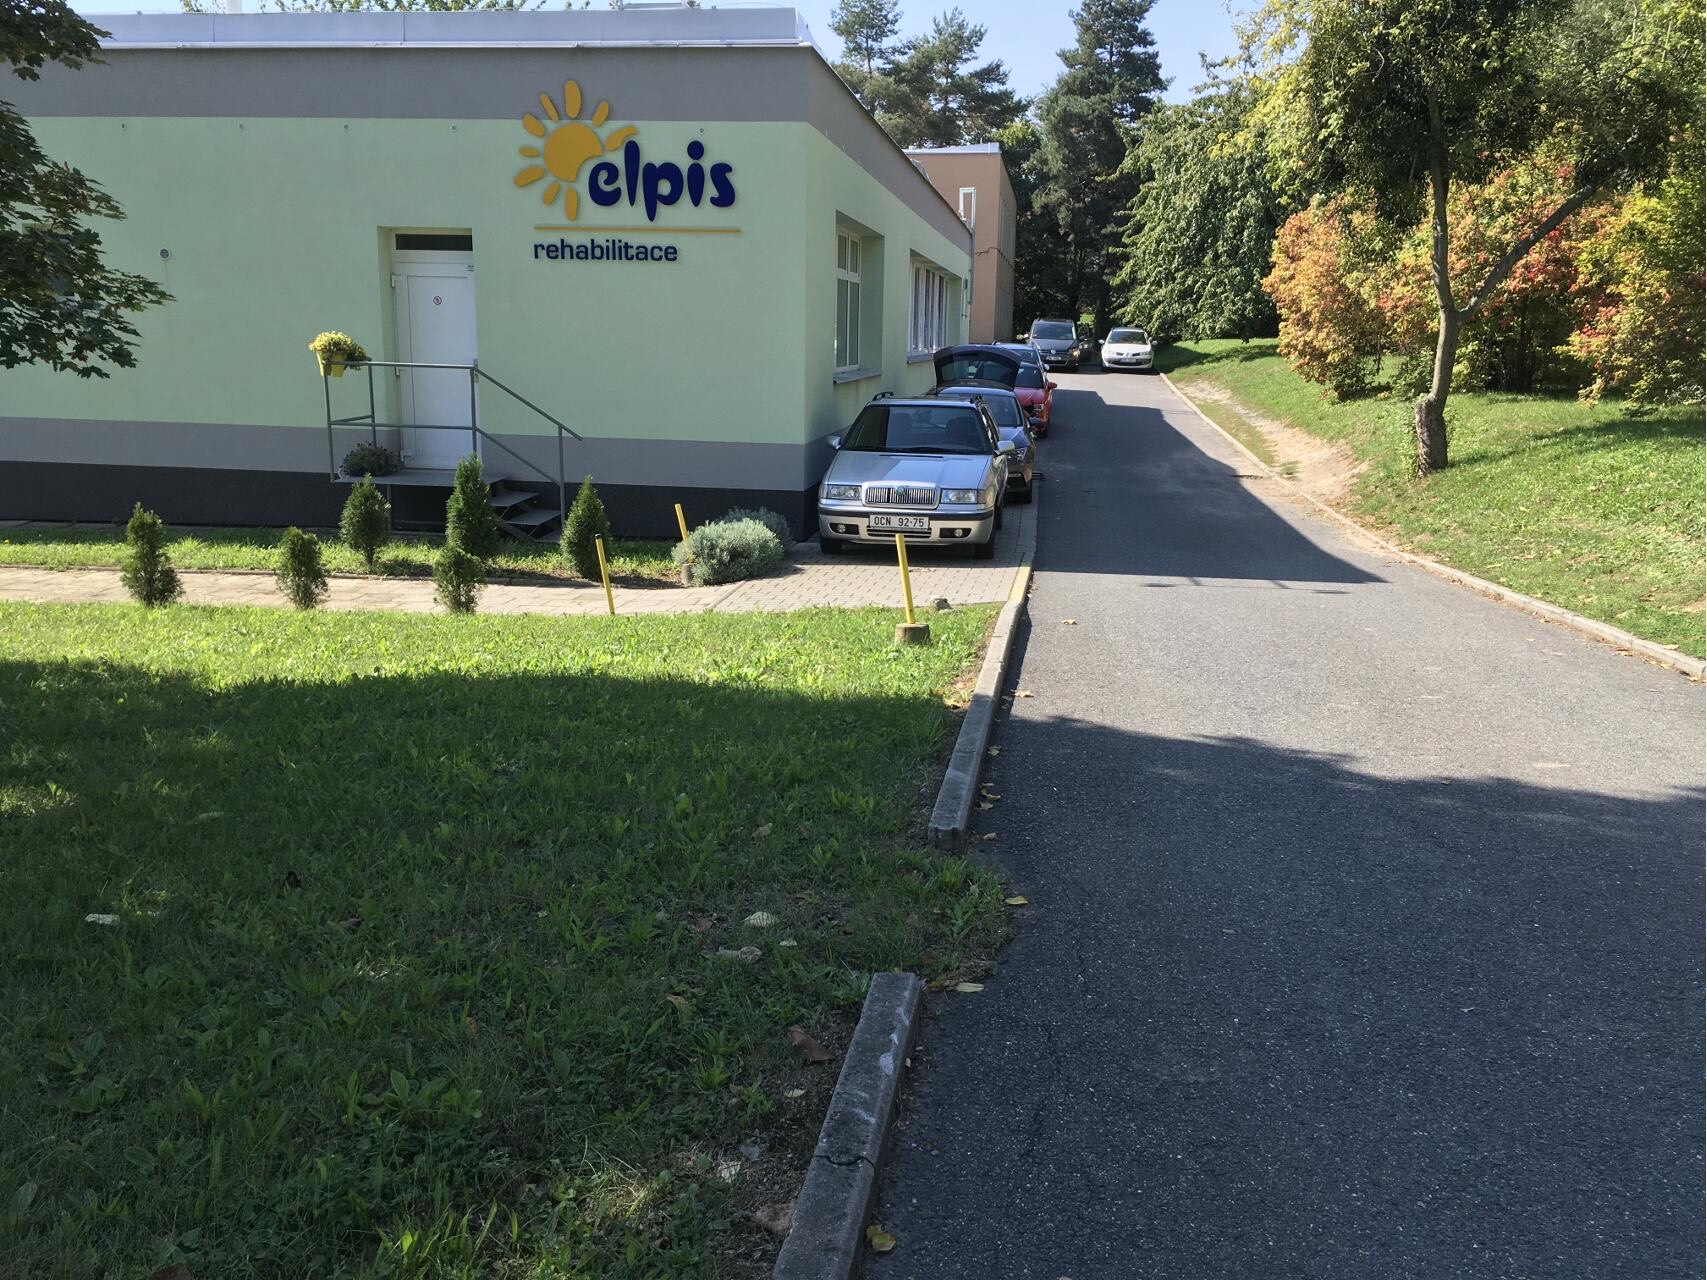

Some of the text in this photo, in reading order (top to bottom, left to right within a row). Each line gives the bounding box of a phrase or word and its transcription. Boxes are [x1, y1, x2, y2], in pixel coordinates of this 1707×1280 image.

[588, 140, 736, 222] elpis
[534, 239, 678, 261] rehabilitace
[873, 516, 925, 528] OCN 92-75
